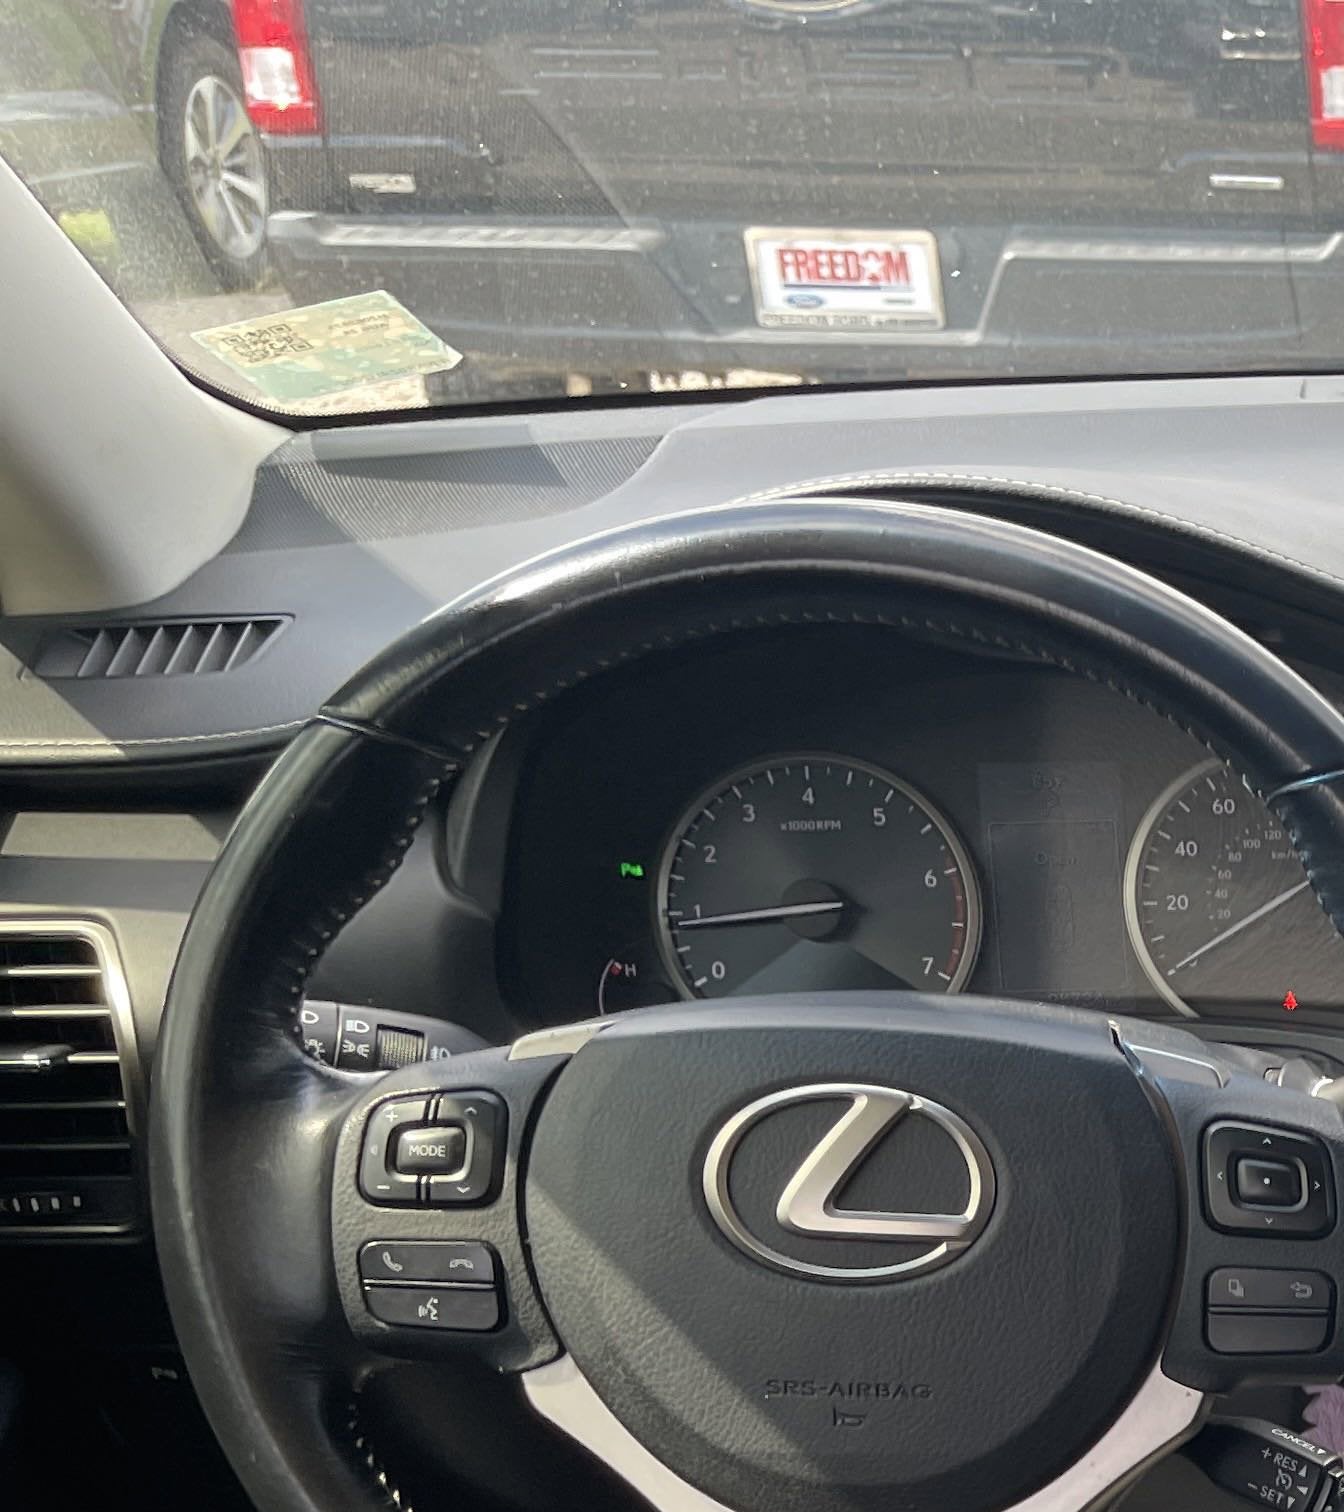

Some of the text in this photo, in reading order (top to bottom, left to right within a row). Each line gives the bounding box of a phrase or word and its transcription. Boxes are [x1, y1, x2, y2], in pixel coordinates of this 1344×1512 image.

[777, 248, 911, 284] FREEDOM
[801, 786, 815, 805] 4
[741, 803, 756, 823] 3
[1211, 799, 1236, 815] 60
[872, 807, 886, 826] 5
[1242, 839, 1261, 849] 100
[1264, 830, 1281, 841] 120
[702, 845, 717, 864] 2
[1175, 840, 1198, 857] 40
[1228, 851, 1242, 862] 80
[923, 869, 938, 888] 6
[1217, 869, 1232, 880] 60
[1214, 888, 1228, 899] 40
[1166, 894, 1189, 911] 20
[1217, 909, 1231, 919] 20
[624, 963, 637, 977] H
[711, 960, 726, 980] 0
[921, 956, 934, 976] 7
[408, 1144, 446, 1158] MODE
[766, 1379, 934, 1400] SRS-AIRBAG
[1271, 1427, 1316, 1453] CANCEL
